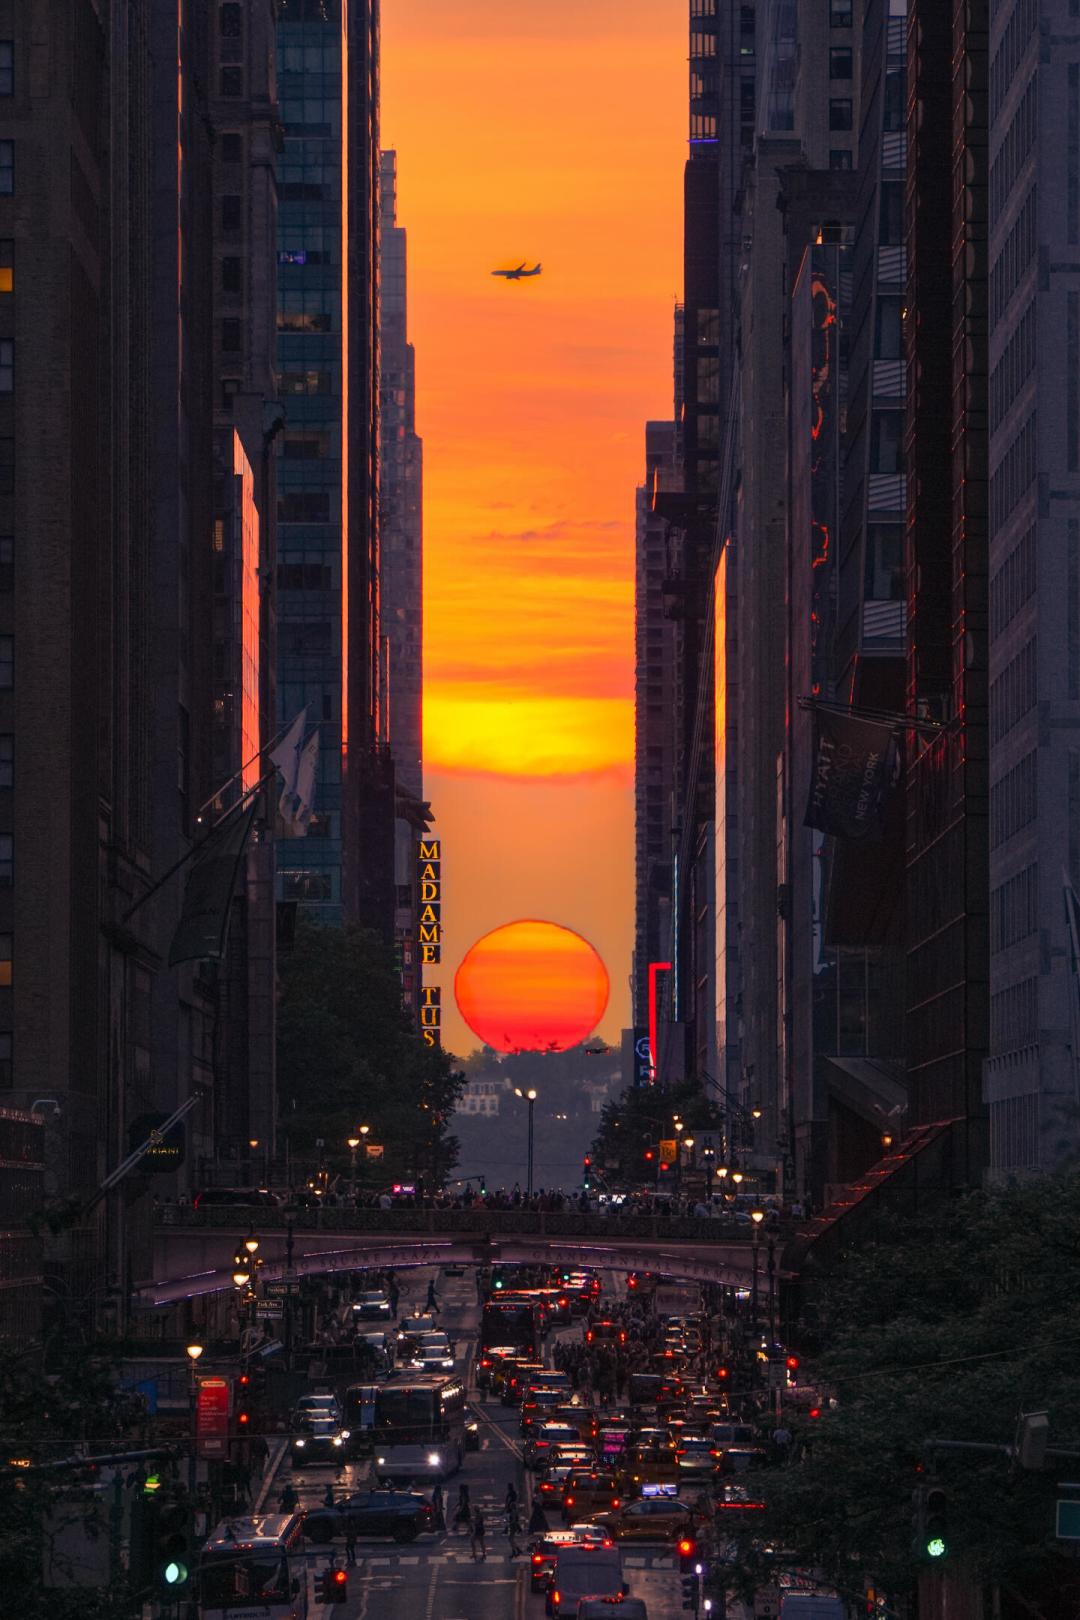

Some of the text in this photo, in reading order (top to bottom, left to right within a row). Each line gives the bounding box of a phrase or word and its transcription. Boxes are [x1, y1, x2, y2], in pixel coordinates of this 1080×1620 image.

[813, 736, 835, 807] HYATT
[855, 752, 881, 821] NEW YORK
[418, 842, 439, 964] MADAME
[319, 1253, 381, 1269] SQUARE
[391, 1251, 441, 1261] PLAZA
[532, 1250, 588, 1262] GRAND
[599, 1254, 673, 1271] CENTRAL
